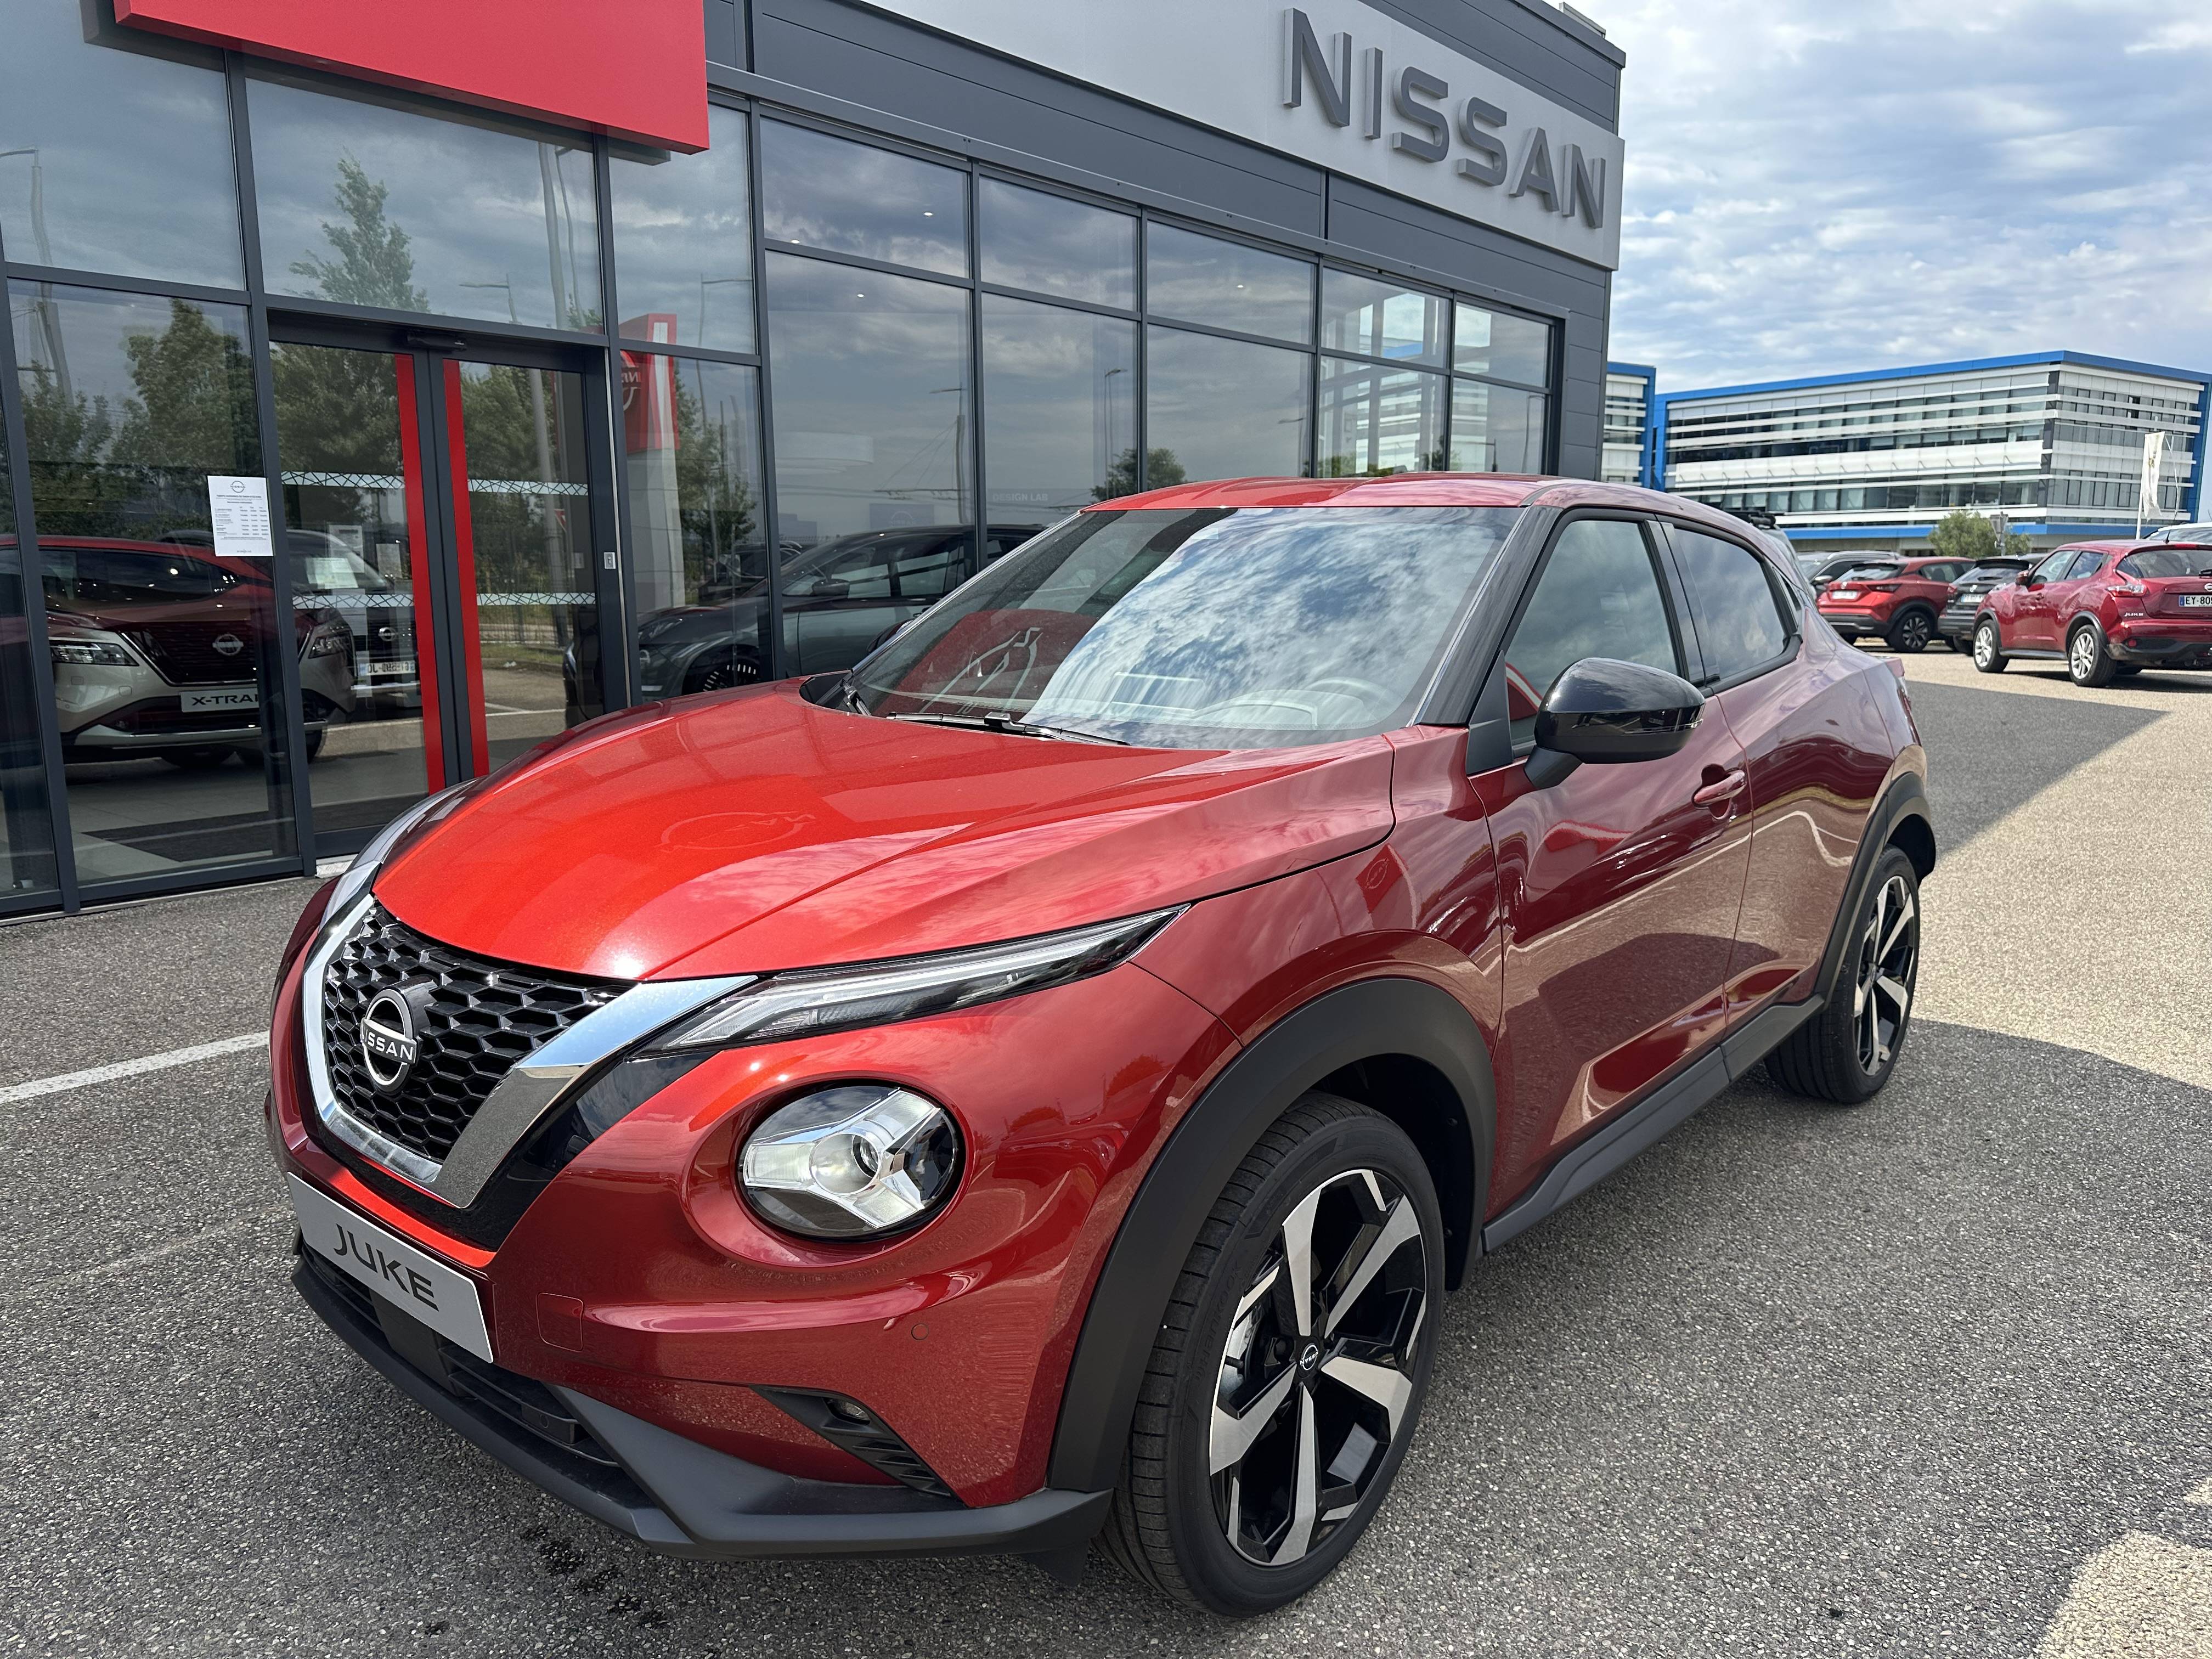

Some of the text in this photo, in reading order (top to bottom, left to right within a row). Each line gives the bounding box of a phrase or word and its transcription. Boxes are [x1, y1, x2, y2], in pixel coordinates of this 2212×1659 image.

[1283, 8, 1606, 229] NISSAN
[992, 493, 1048, 501] DESIGN LAB
[2186, 596, 2212, 605] EY-80
[334, 1223, 439, 1312] JUKE
